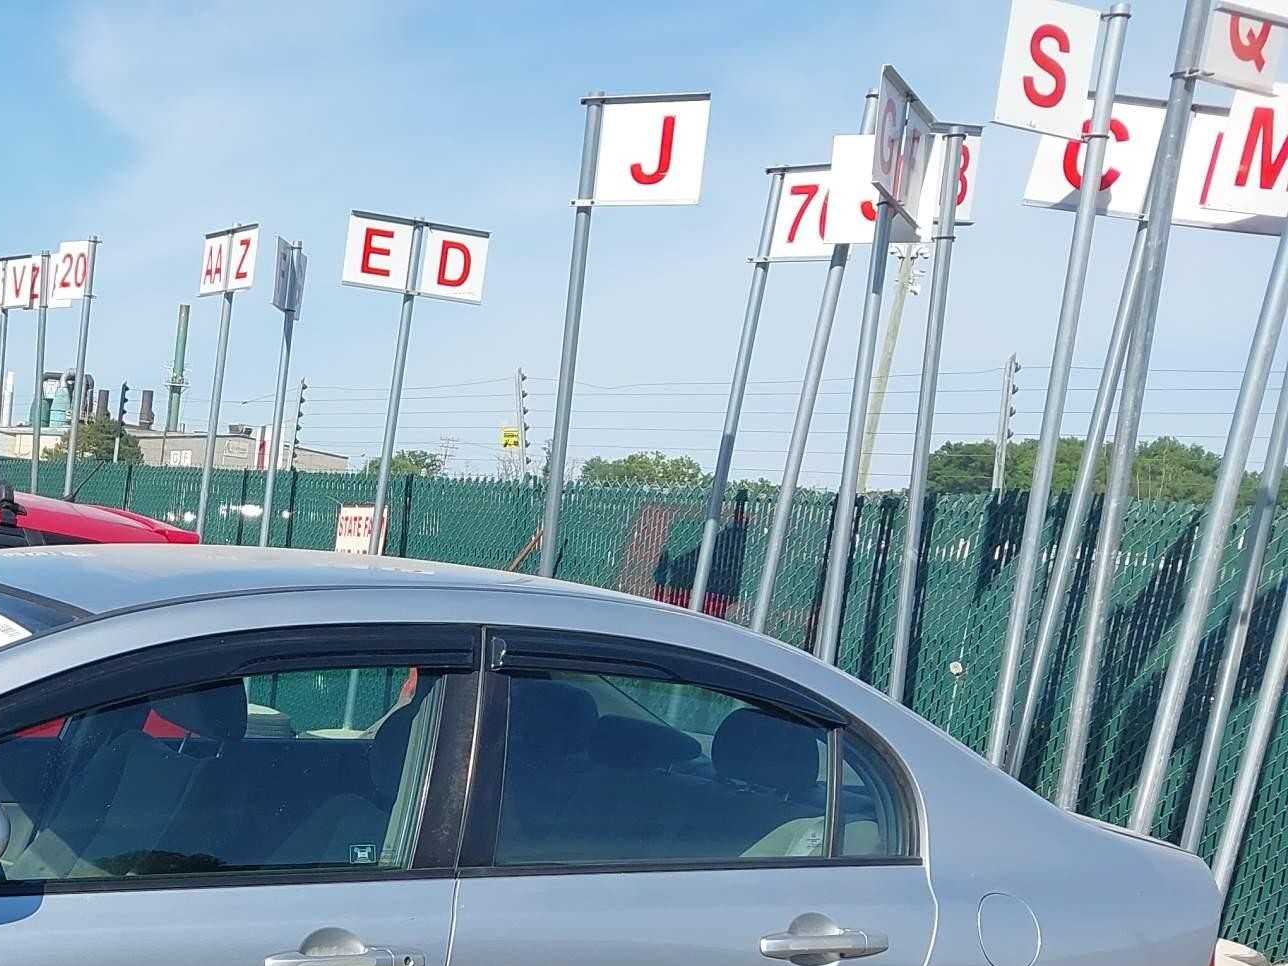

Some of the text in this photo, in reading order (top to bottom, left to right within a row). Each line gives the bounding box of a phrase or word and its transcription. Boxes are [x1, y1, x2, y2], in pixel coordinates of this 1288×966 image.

[1022, 23, 1071, 109] S
[1229, 14, 1273, 73] Q
[630, 115, 676, 185] J
[1062, 117, 1131, 191] C
[1234, 106, 1288, 190] M
[59, 252, 88, 288] 20
[203, 243, 223, 286] AA
[234, 237, 252, 280] Z
[360, 227, 395, 278] E
[436, 239, 472, 288] D
[13, 264, 27, 299] V
[338, 516, 363, 537] STATE
